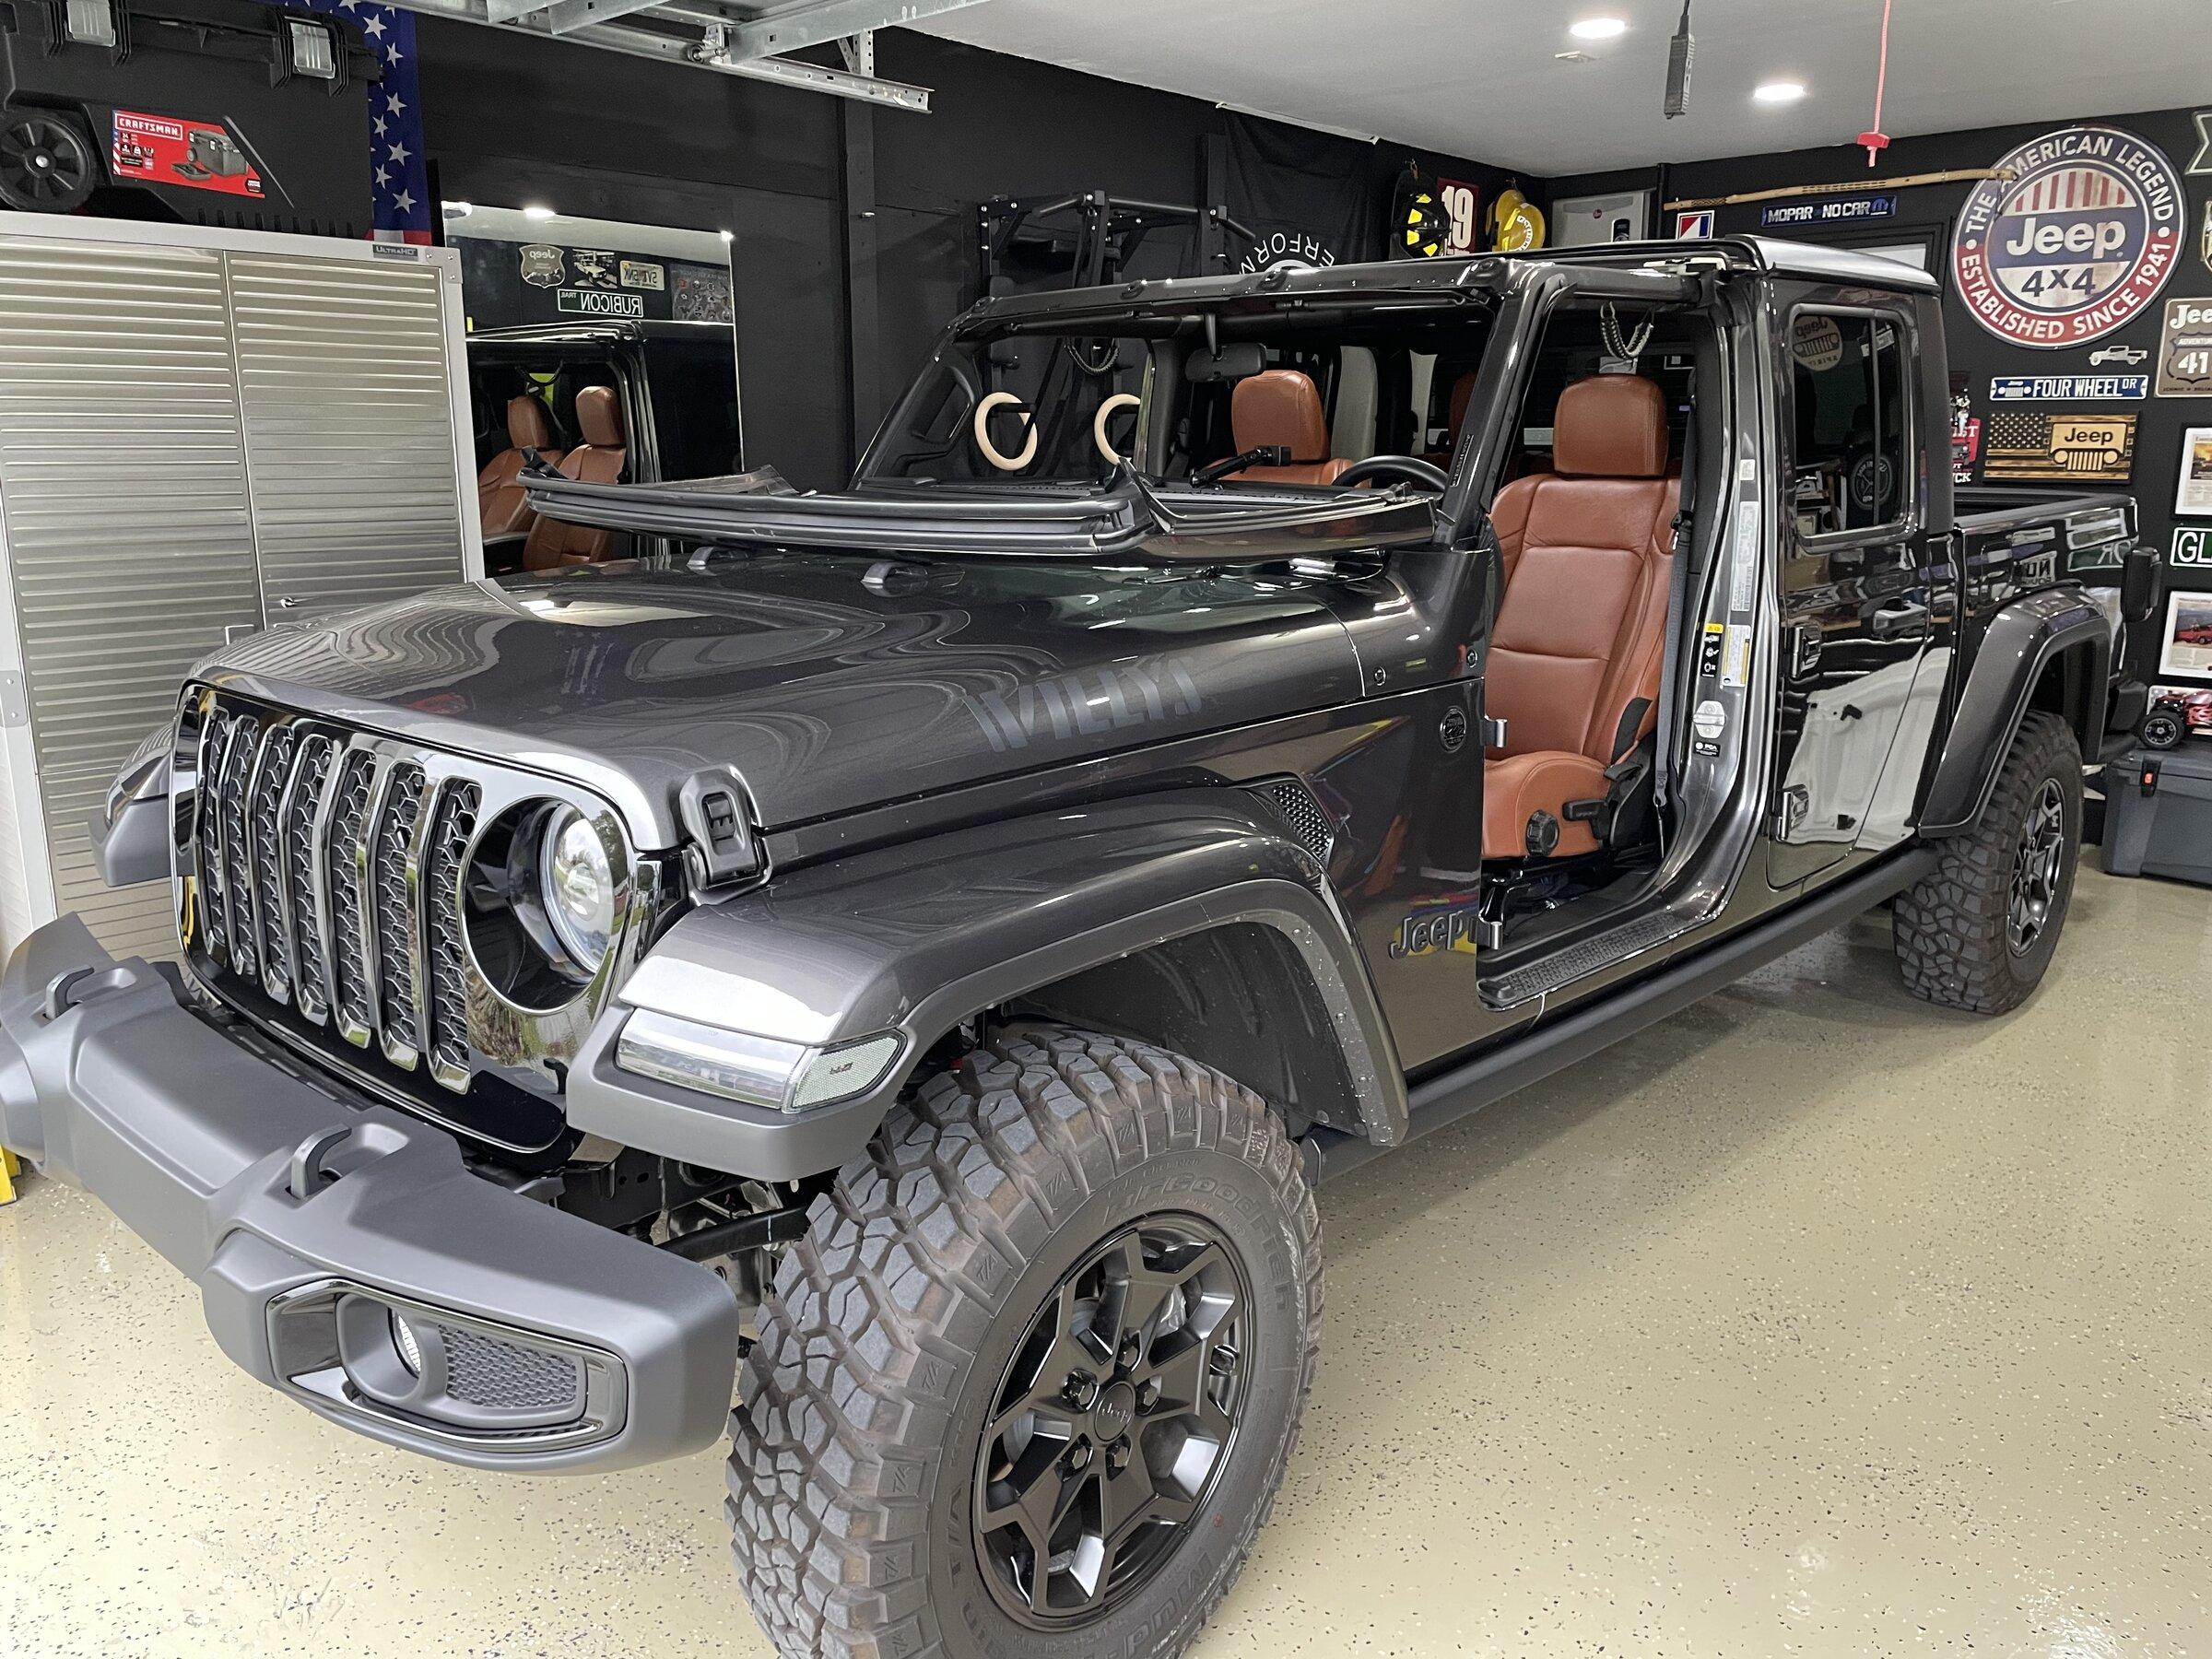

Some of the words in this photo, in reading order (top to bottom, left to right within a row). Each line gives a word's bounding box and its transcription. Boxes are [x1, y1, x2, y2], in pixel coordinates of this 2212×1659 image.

[119, 117, 179, 136] CRAFTSMAN
[1965, 192, 1997, 233] THE
[2115, 144, 2174, 221] LEGEND
[1768, 206, 1813, 223] MOPAR
[1821, 204, 1841, 218] NO
[1841, 201, 1871, 216] CAR
[2006, 217, 2126, 259] Jeep
[1961, 253, 2065, 339] ESTABLISHED
[2073, 288, 2141, 336] SINCE
[2136, 241, 2171, 287] 1941
[2169, 304, 2212, 329] Jee
[2178, 351, 2209, 374] 41
[2032, 379, 2072, 397] FOUR
[2075, 378, 2123, 397] WHEEL
[2122, 378, 2138, 389] DR
[2065, 427, 2113, 445] Jeep
[2178, 531, 2212, 563] GL
[1387, 910, 1465, 959] Jeep
